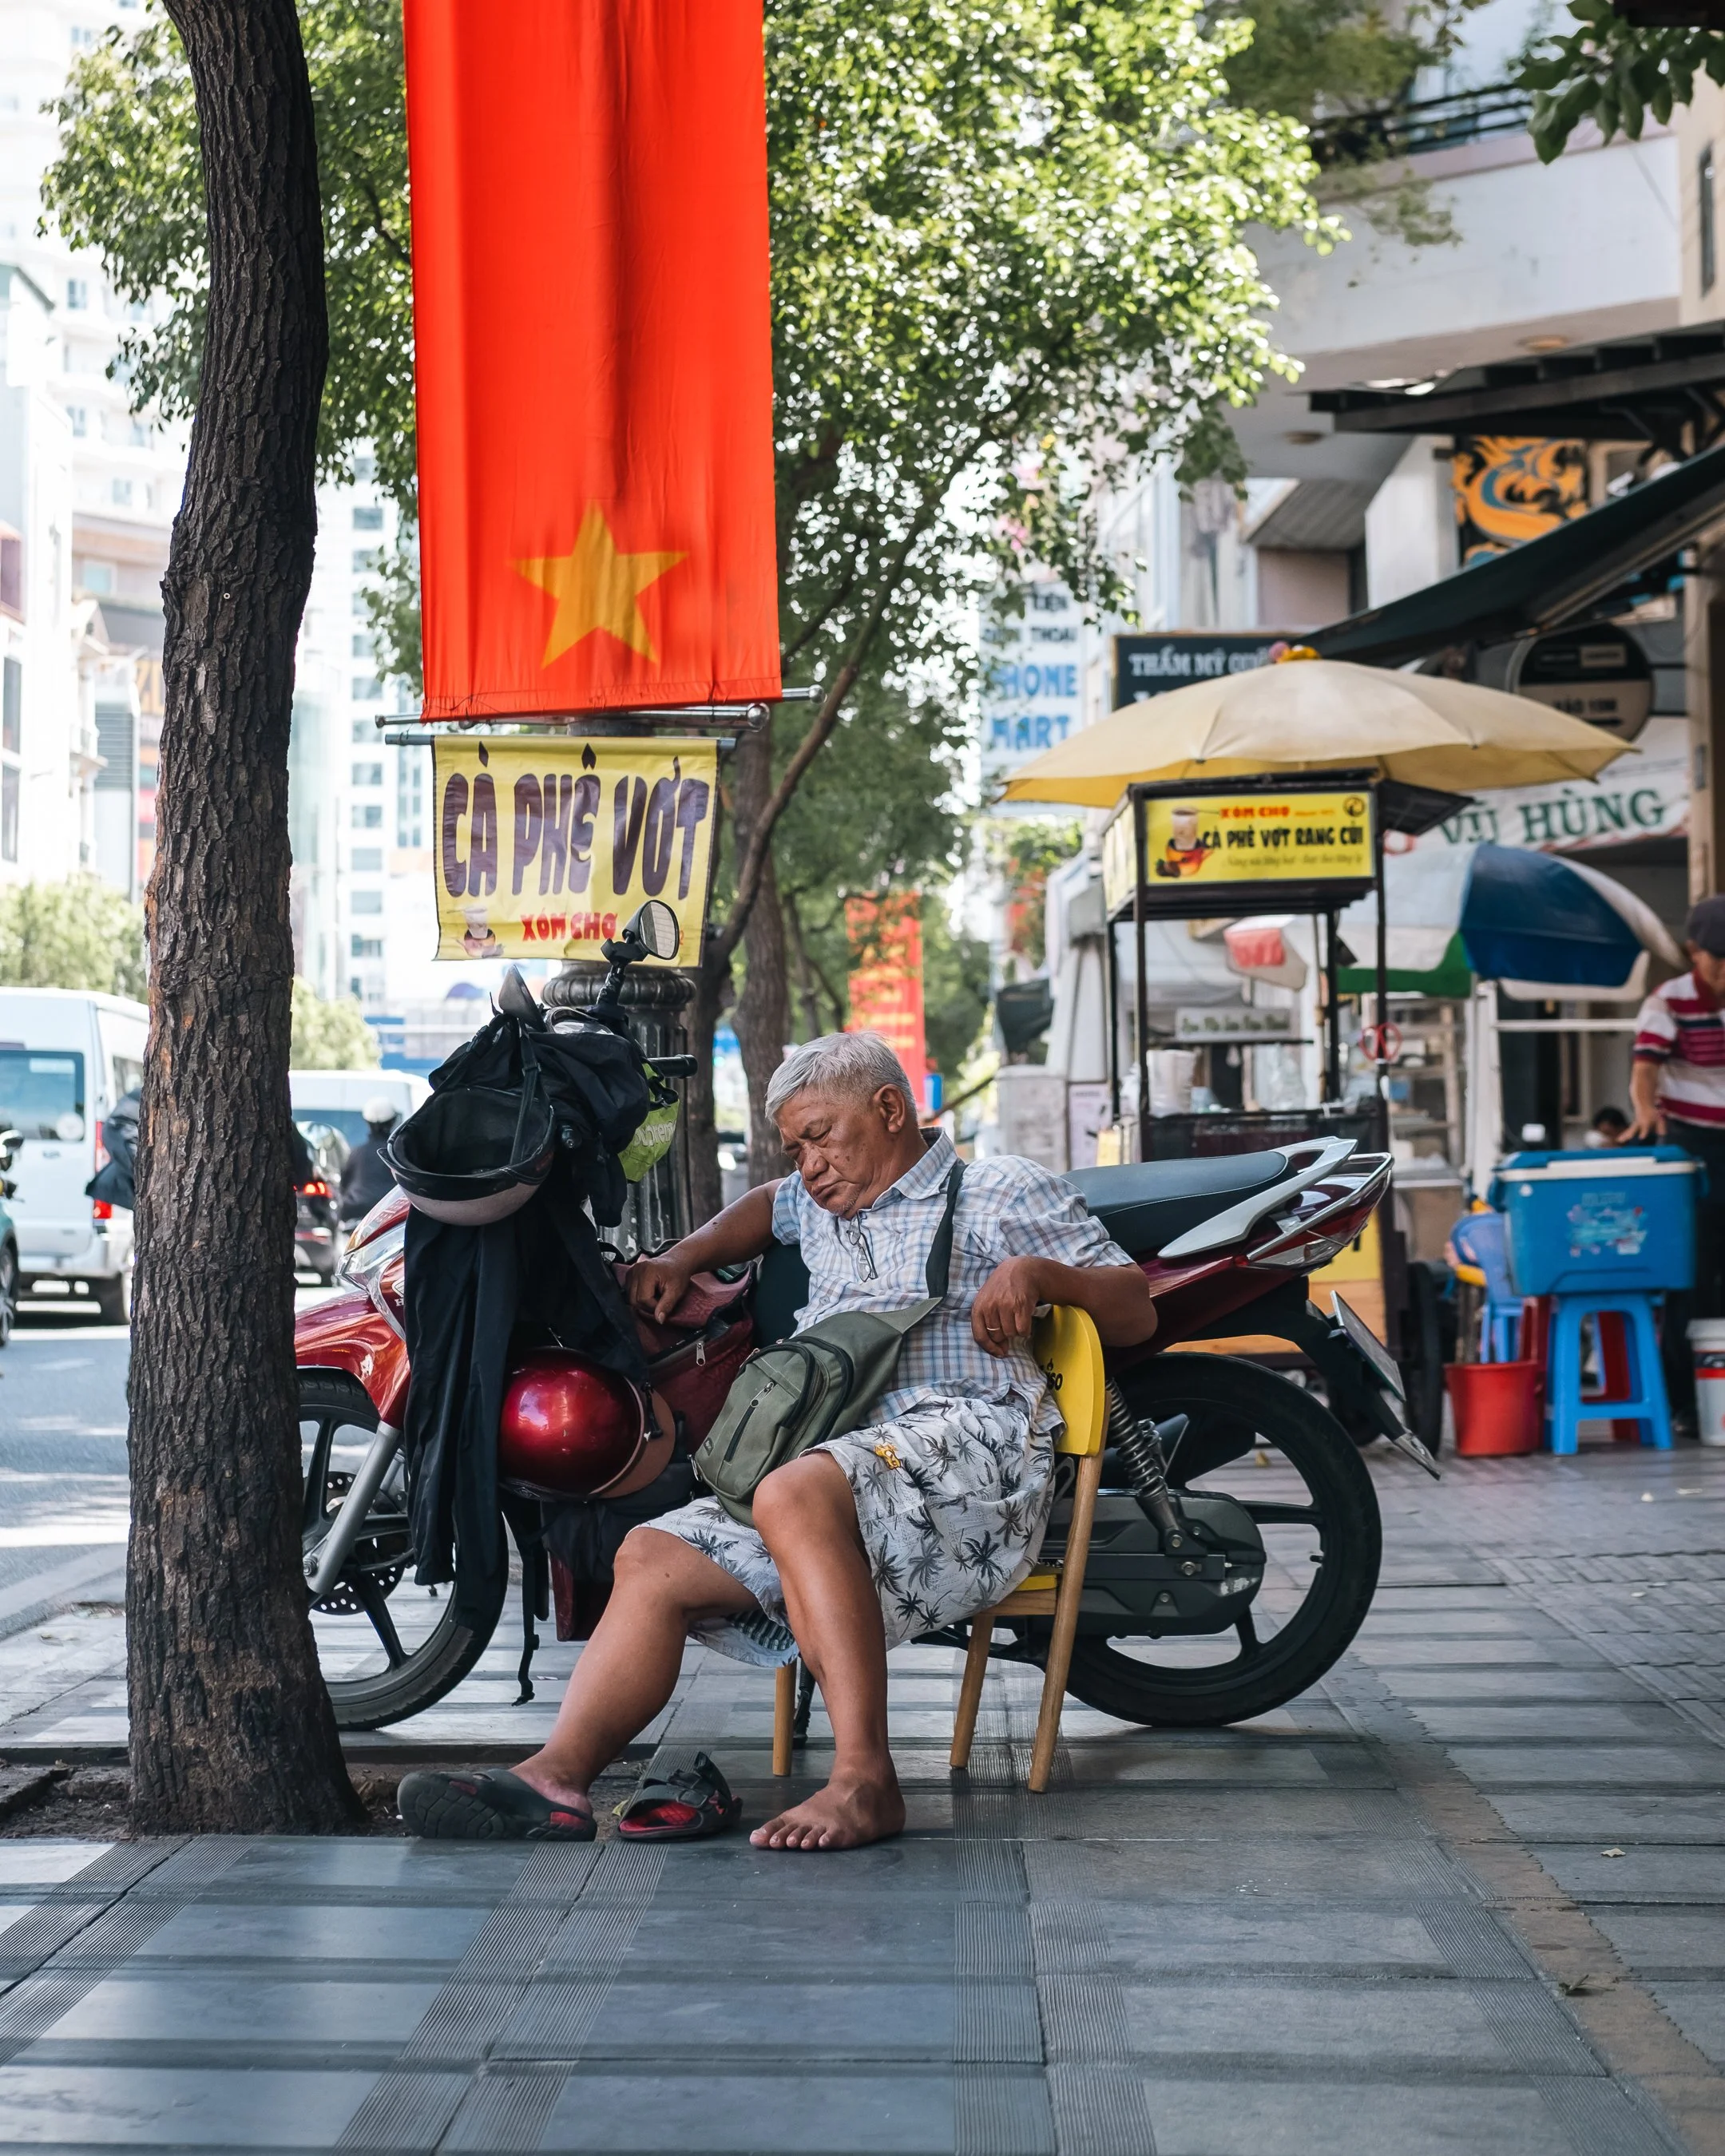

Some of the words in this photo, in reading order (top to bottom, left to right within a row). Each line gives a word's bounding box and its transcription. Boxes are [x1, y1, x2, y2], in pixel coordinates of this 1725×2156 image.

[442, 741, 498, 898] CÀ
[511, 743, 601, 896] PHÊ
[1518, 788, 1667, 843] HÙNG
